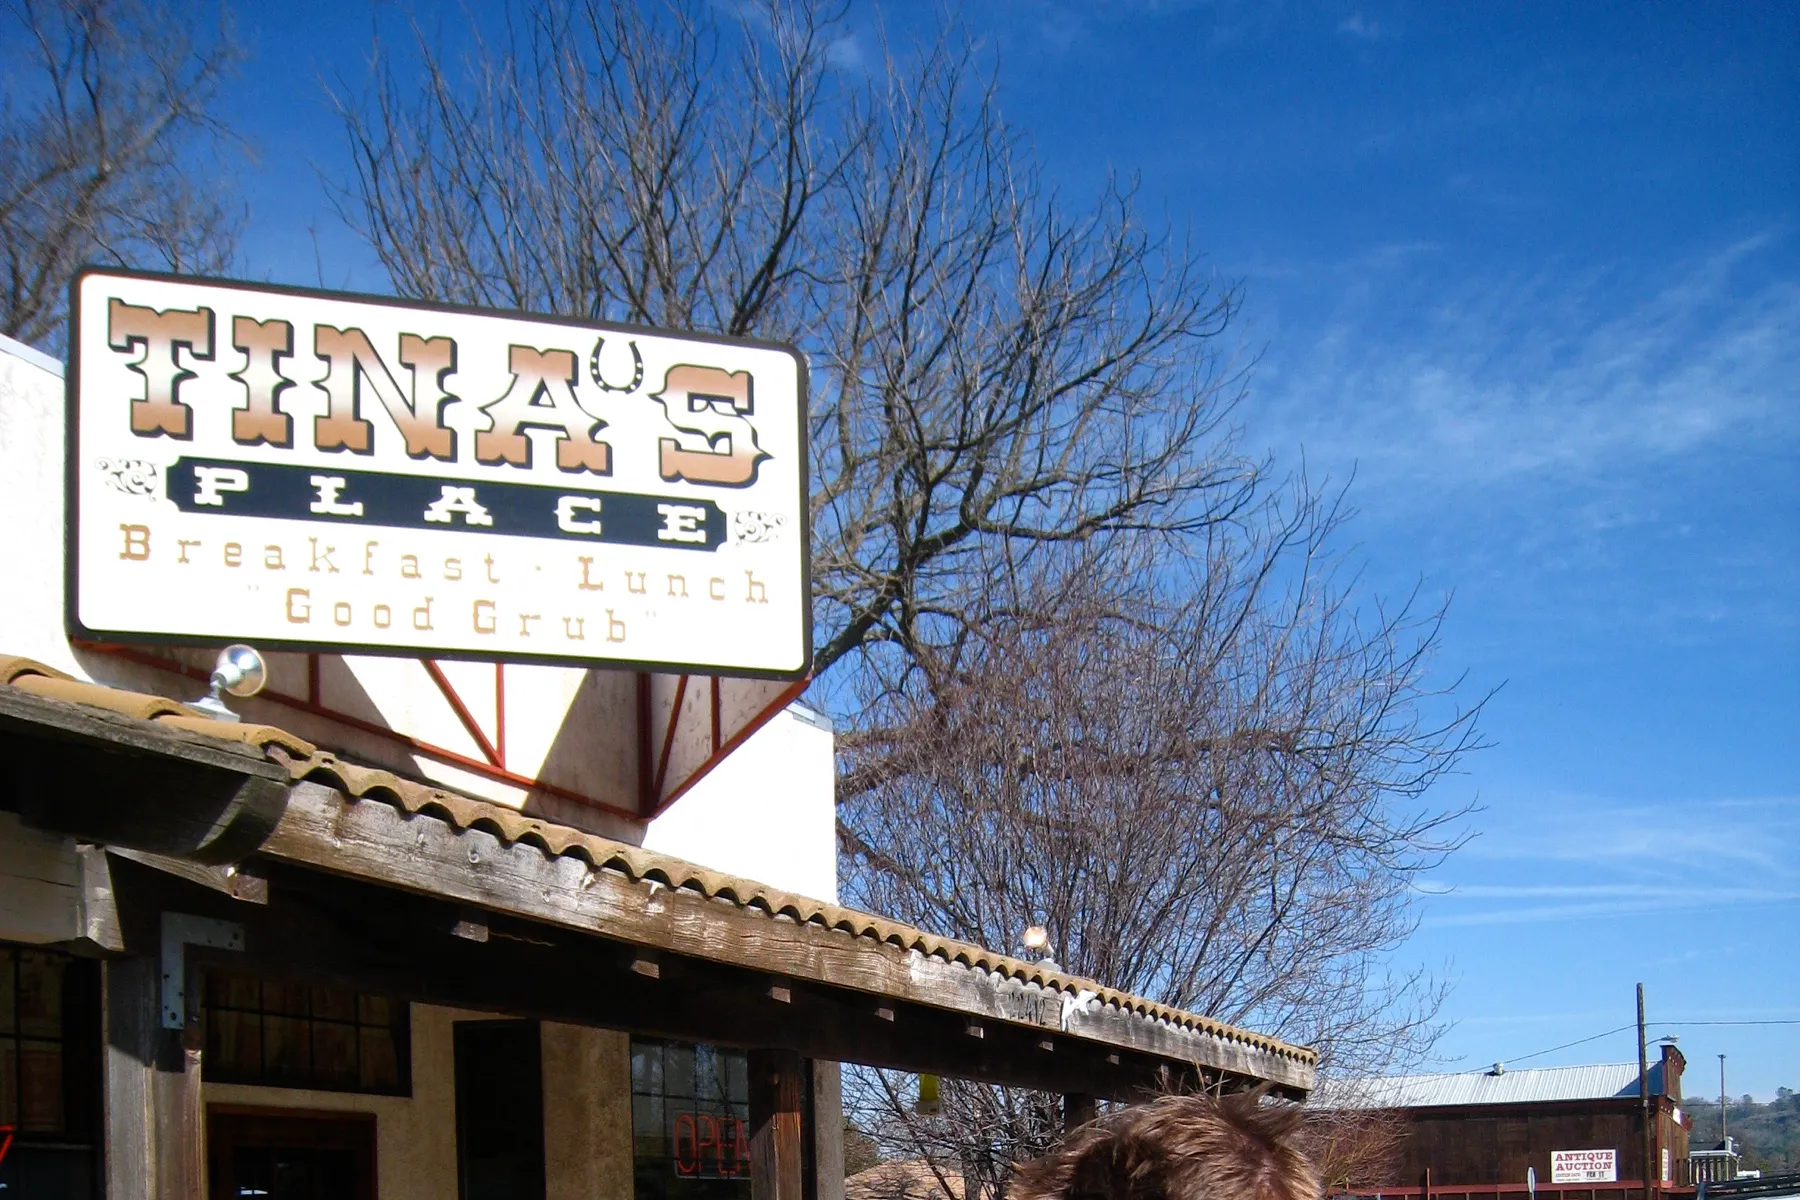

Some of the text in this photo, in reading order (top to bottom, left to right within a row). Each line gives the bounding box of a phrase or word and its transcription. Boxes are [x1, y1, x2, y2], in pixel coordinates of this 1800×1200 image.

[193, 466, 708, 543] PLACE
[118, 523, 770, 604] Breakfast Lunch
[1555, 1152, 1613, 1162] ANTIQUE
[1555, 1162, 1613, 1171] AUCTION
